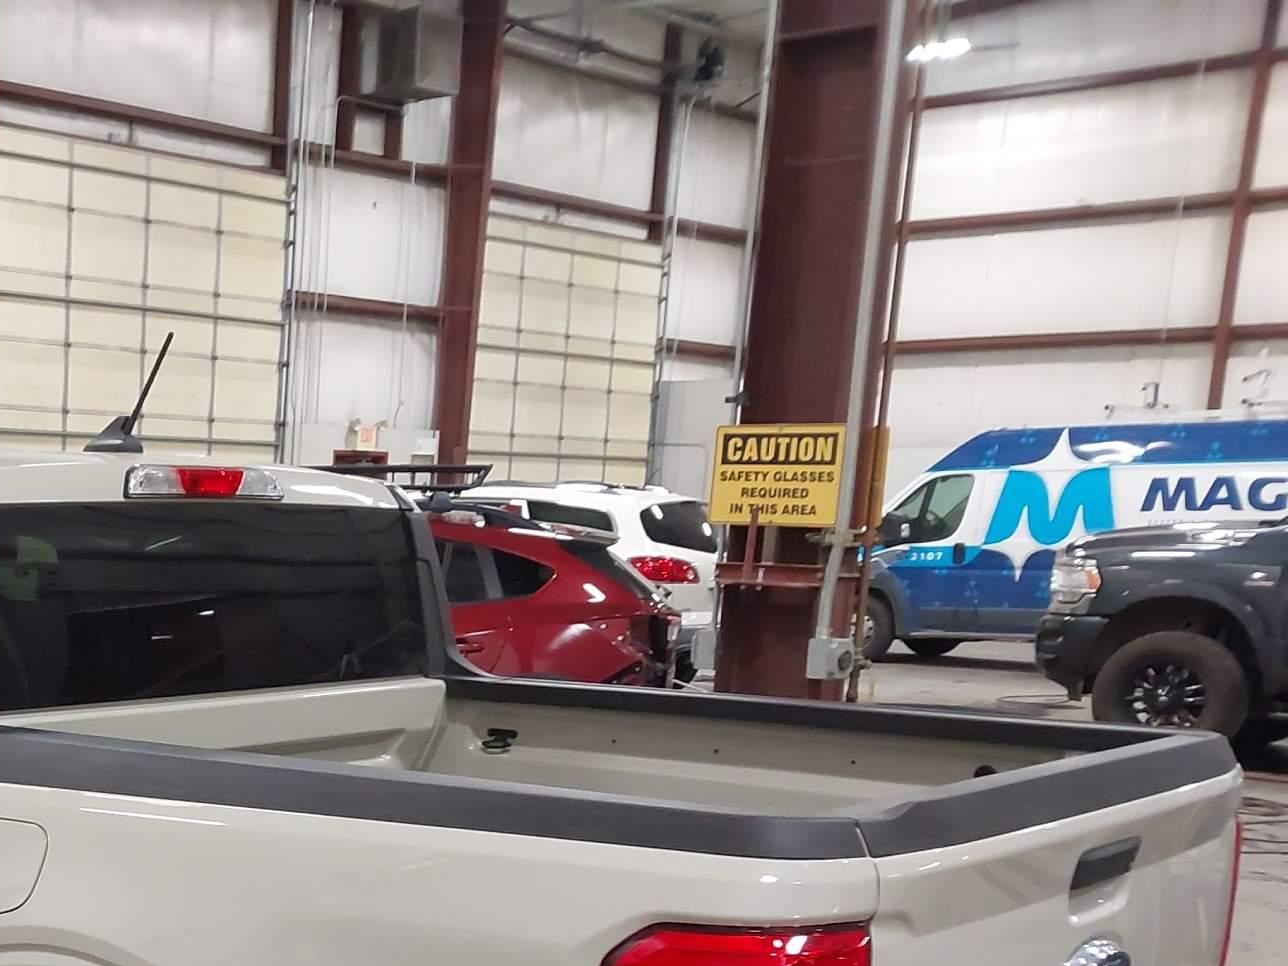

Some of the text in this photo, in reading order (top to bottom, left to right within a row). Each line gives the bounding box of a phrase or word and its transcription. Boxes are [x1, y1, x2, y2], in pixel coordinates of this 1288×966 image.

[726, 436, 835, 462] CAUTION
[720, 470, 835, 483] SAFETY GLASSES
[740, 487, 810, 499] REQUIRED
[1140, 476, 1288, 512] MAG
[729, 503, 817, 515] IN THIS AREA
[910, 551, 943, 561] 2107
